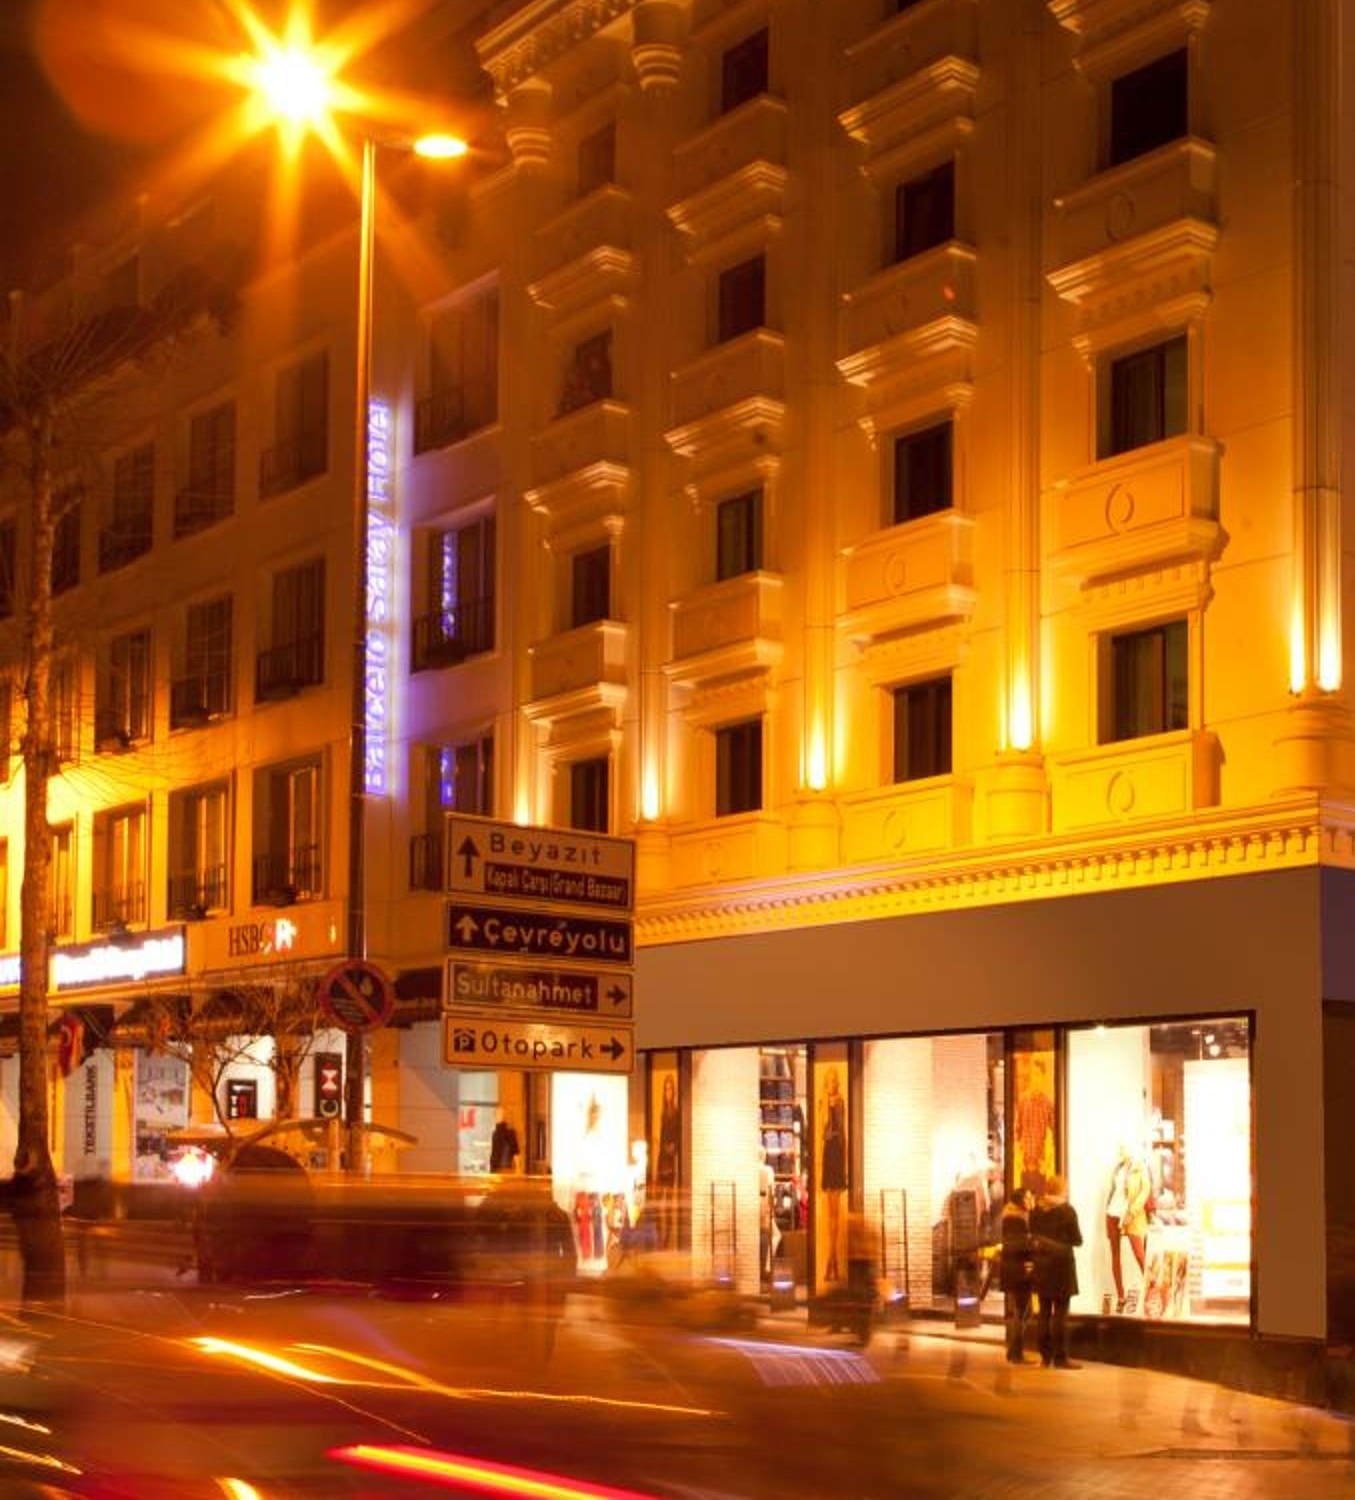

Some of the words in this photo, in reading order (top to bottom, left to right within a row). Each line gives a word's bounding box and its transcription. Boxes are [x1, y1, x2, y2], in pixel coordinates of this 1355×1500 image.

[484, 919, 625, 953] Çevreyolu
[457, 972, 593, 1004] Sultanahmet
[481, 1031, 593, 1059] Otopark
